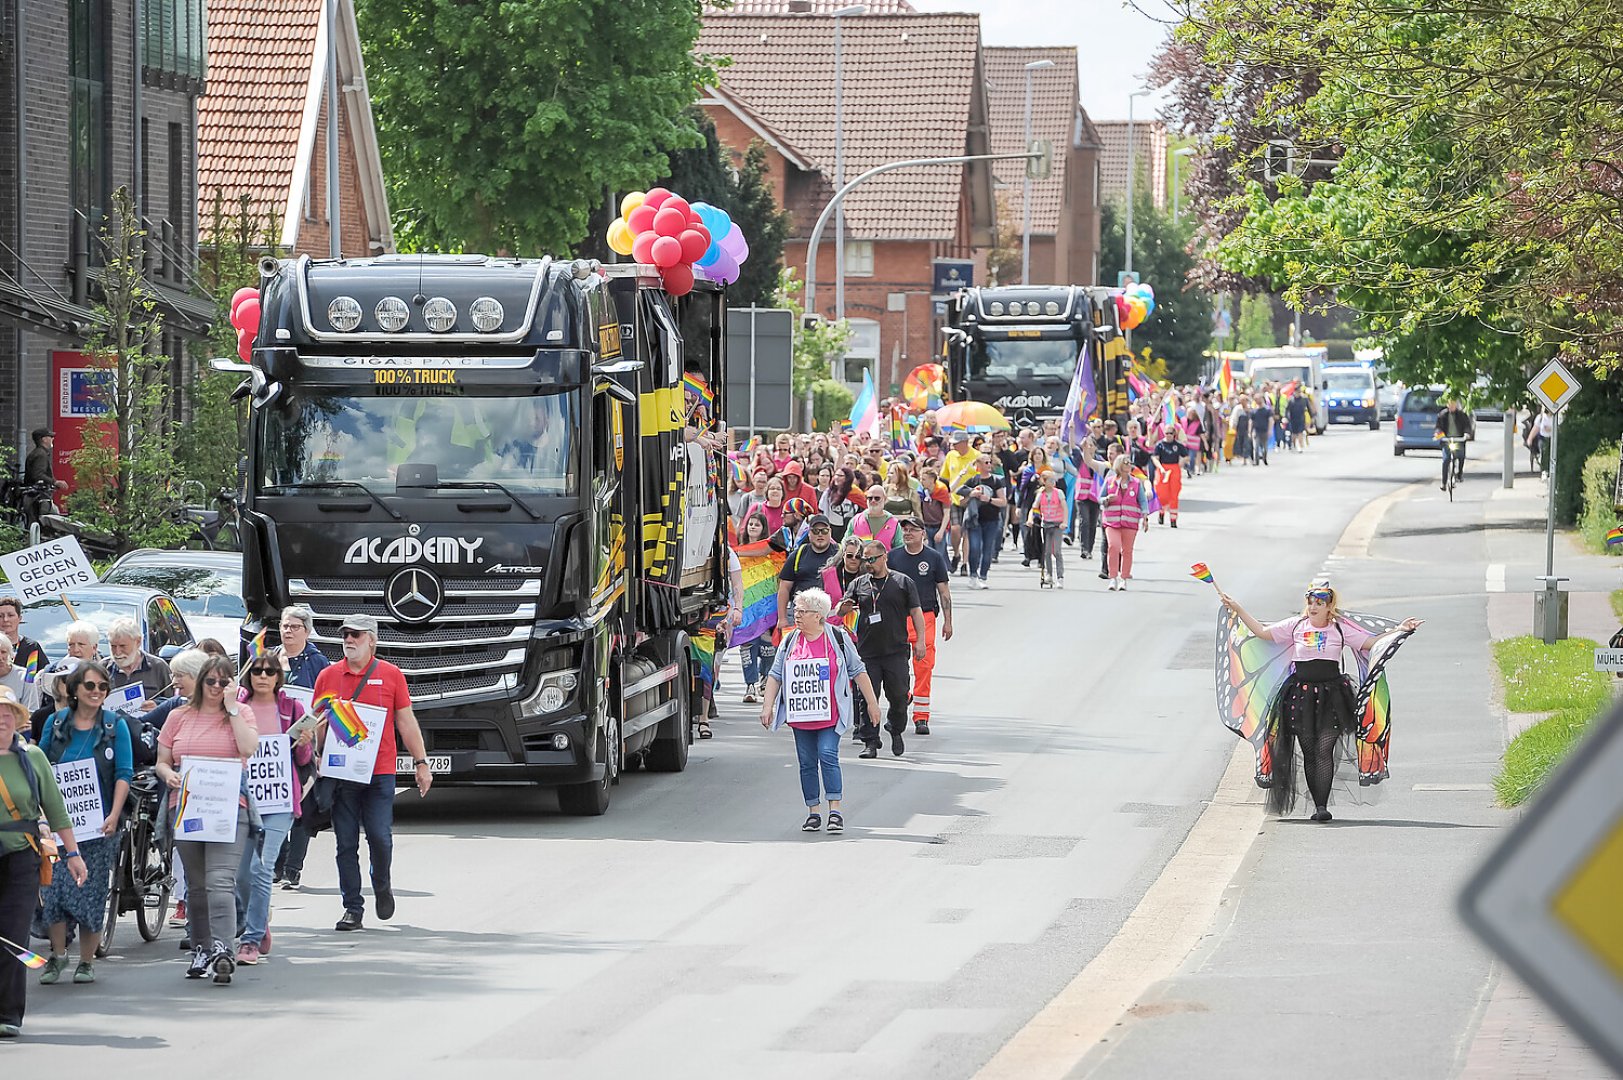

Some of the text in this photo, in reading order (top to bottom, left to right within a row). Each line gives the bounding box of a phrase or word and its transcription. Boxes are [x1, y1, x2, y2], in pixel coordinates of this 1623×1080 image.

[413, 369, 456, 384] TRUCK
[16, 544, 64, 567] OMAS
[20, 557, 78, 583] GEGEN
[23, 571, 89, 600] RECHTS
[791, 679, 825, 695] GEGEN
[789, 696, 829, 712] RECHTS
[247, 761, 285, 780] EGEN
[429, 758, 450, 770] 789
[63, 767, 91, 784] BESTE
[66, 798, 100, 815] UNSERE
